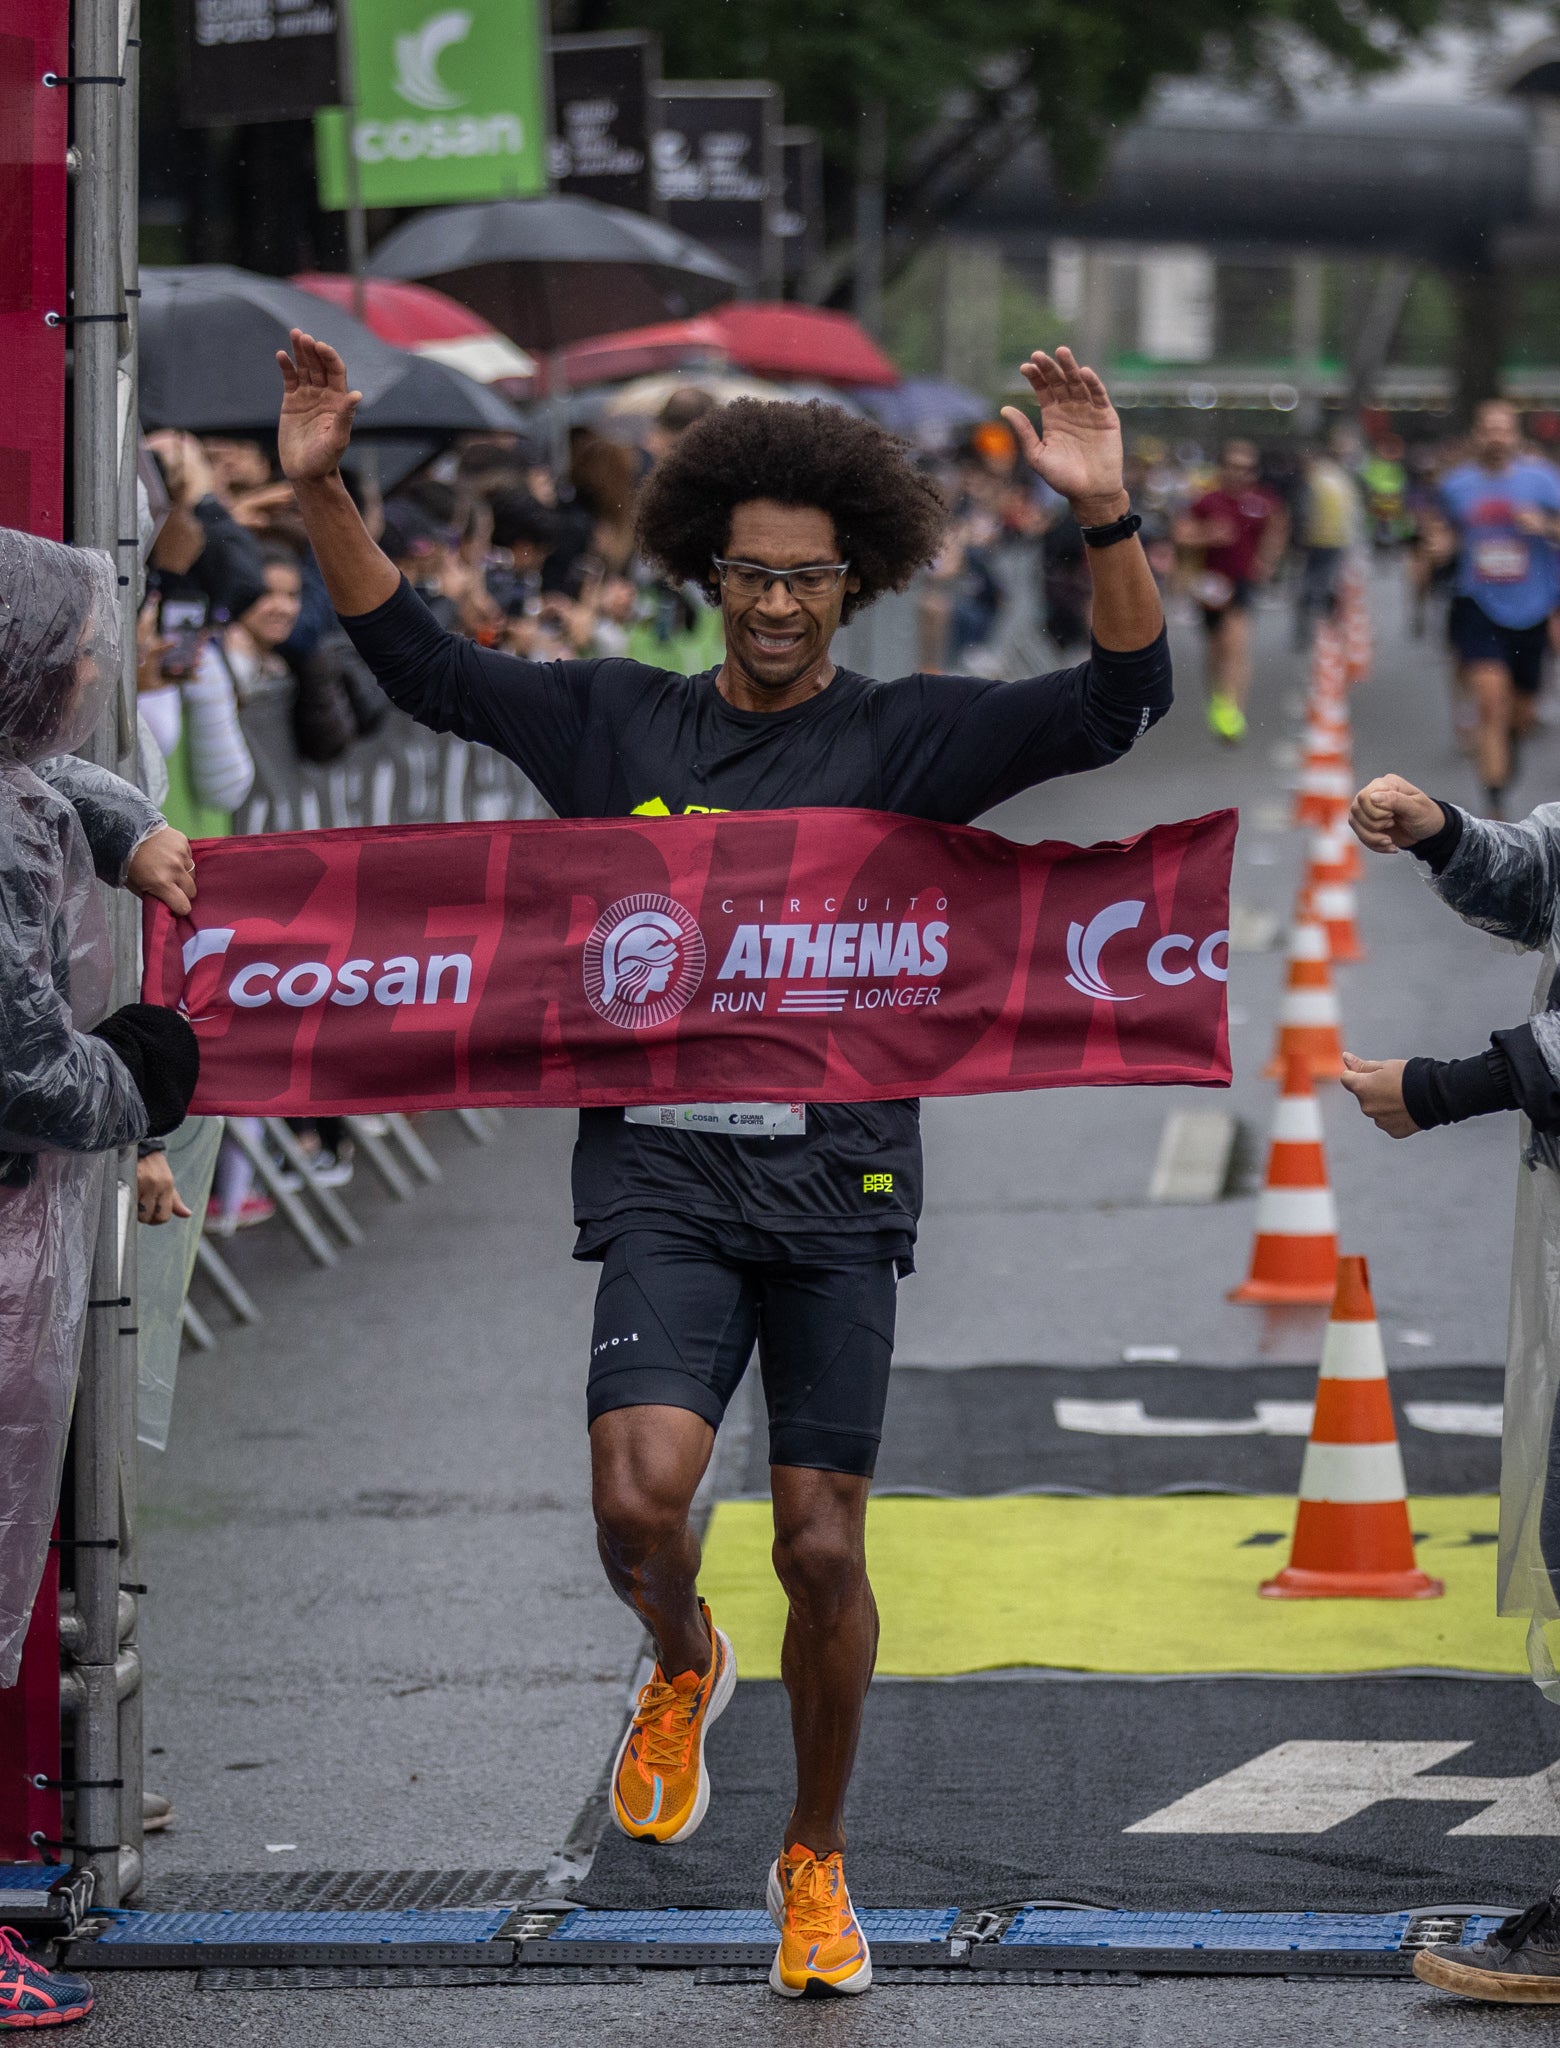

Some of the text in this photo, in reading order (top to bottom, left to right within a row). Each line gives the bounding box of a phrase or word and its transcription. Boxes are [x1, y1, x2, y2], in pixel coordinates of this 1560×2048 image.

[353, 113, 523, 163] cosan
[721, 897, 948, 914] CIRCUITO
[716, 920, 950, 980] ATHENAS
[228, 952, 473, 1008] cosan
[711, 987, 941, 1013] RUN LONGER
[692, 1113, 719, 1123] cosan
[863, 1173, 893, 1184] DRO
[863, 1183, 893, 1193] PPZ
[593, 1332, 639, 1356] TWO-E
